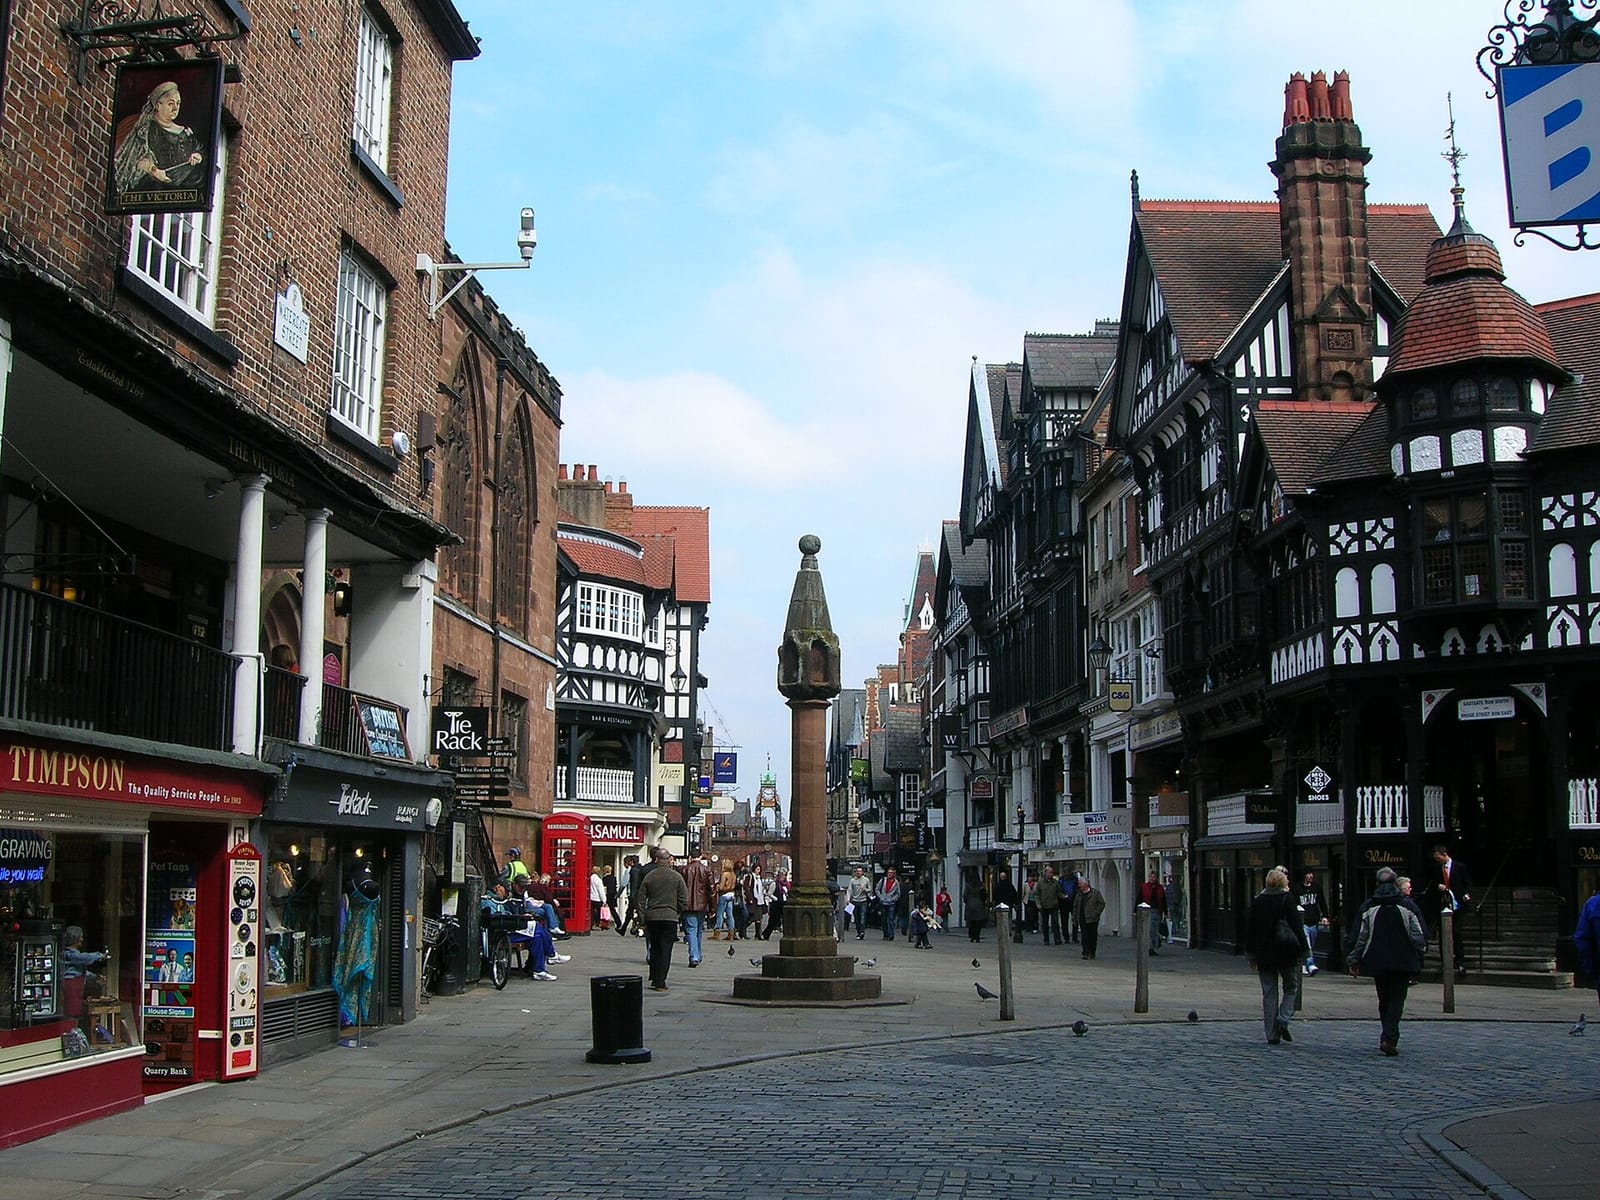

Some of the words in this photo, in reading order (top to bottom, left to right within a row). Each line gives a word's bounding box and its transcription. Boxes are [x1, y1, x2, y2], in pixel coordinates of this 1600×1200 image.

[125, 194, 144, 202] THE
[146, 192, 194, 201] VICTORIA
[281, 324, 303, 352] STREET
[228, 436, 248, 463] THE
[252, 448, 296, 488] VICTORIA
[370, 706, 399, 731] BRITISH
[444, 711, 472, 735] Tie
[436, 731, 483, 750] Rack
[9, 745, 125, 792] TIMPSON
[128, 782, 142, 795] The
[143, 784, 169, 799] Quality
[171, 787, 197, 800] Service
[198, 790, 221, 803] People
[147, 1007, 167, 1015] House
[168, 1007, 186, 1016] Signs
[230, 990, 236, 1012] 1
[248, 988, 256, 1010] 2
[144, 1067, 168, 1077] Quarry
[170, 1067, 187, 1075] Bank
